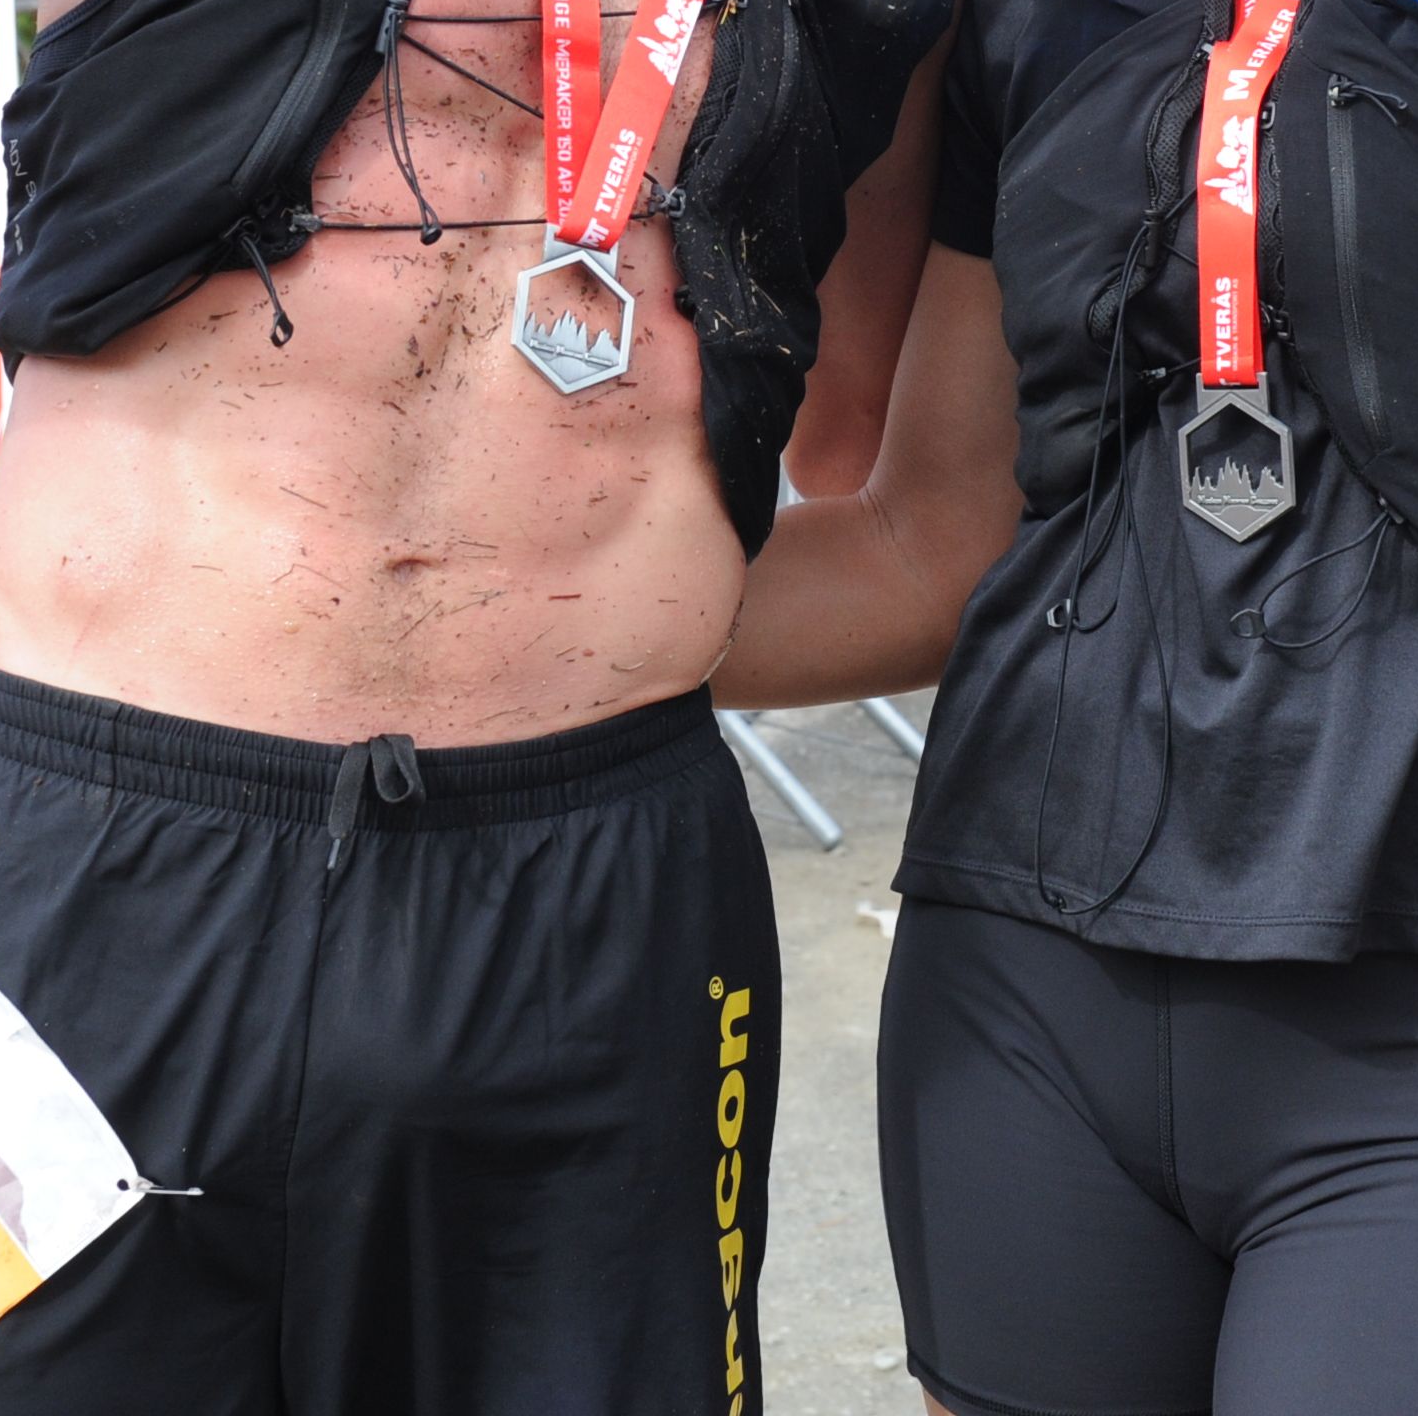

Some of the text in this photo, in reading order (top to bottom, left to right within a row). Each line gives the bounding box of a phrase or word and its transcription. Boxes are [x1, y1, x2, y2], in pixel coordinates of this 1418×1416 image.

[1222, 7, 1296, 102] MERÅKER
[8, 138, 29, 177] ADV
[594, 127, 637, 214] TVERÅS
[1211, 276, 1232, 372] TVERÅS
